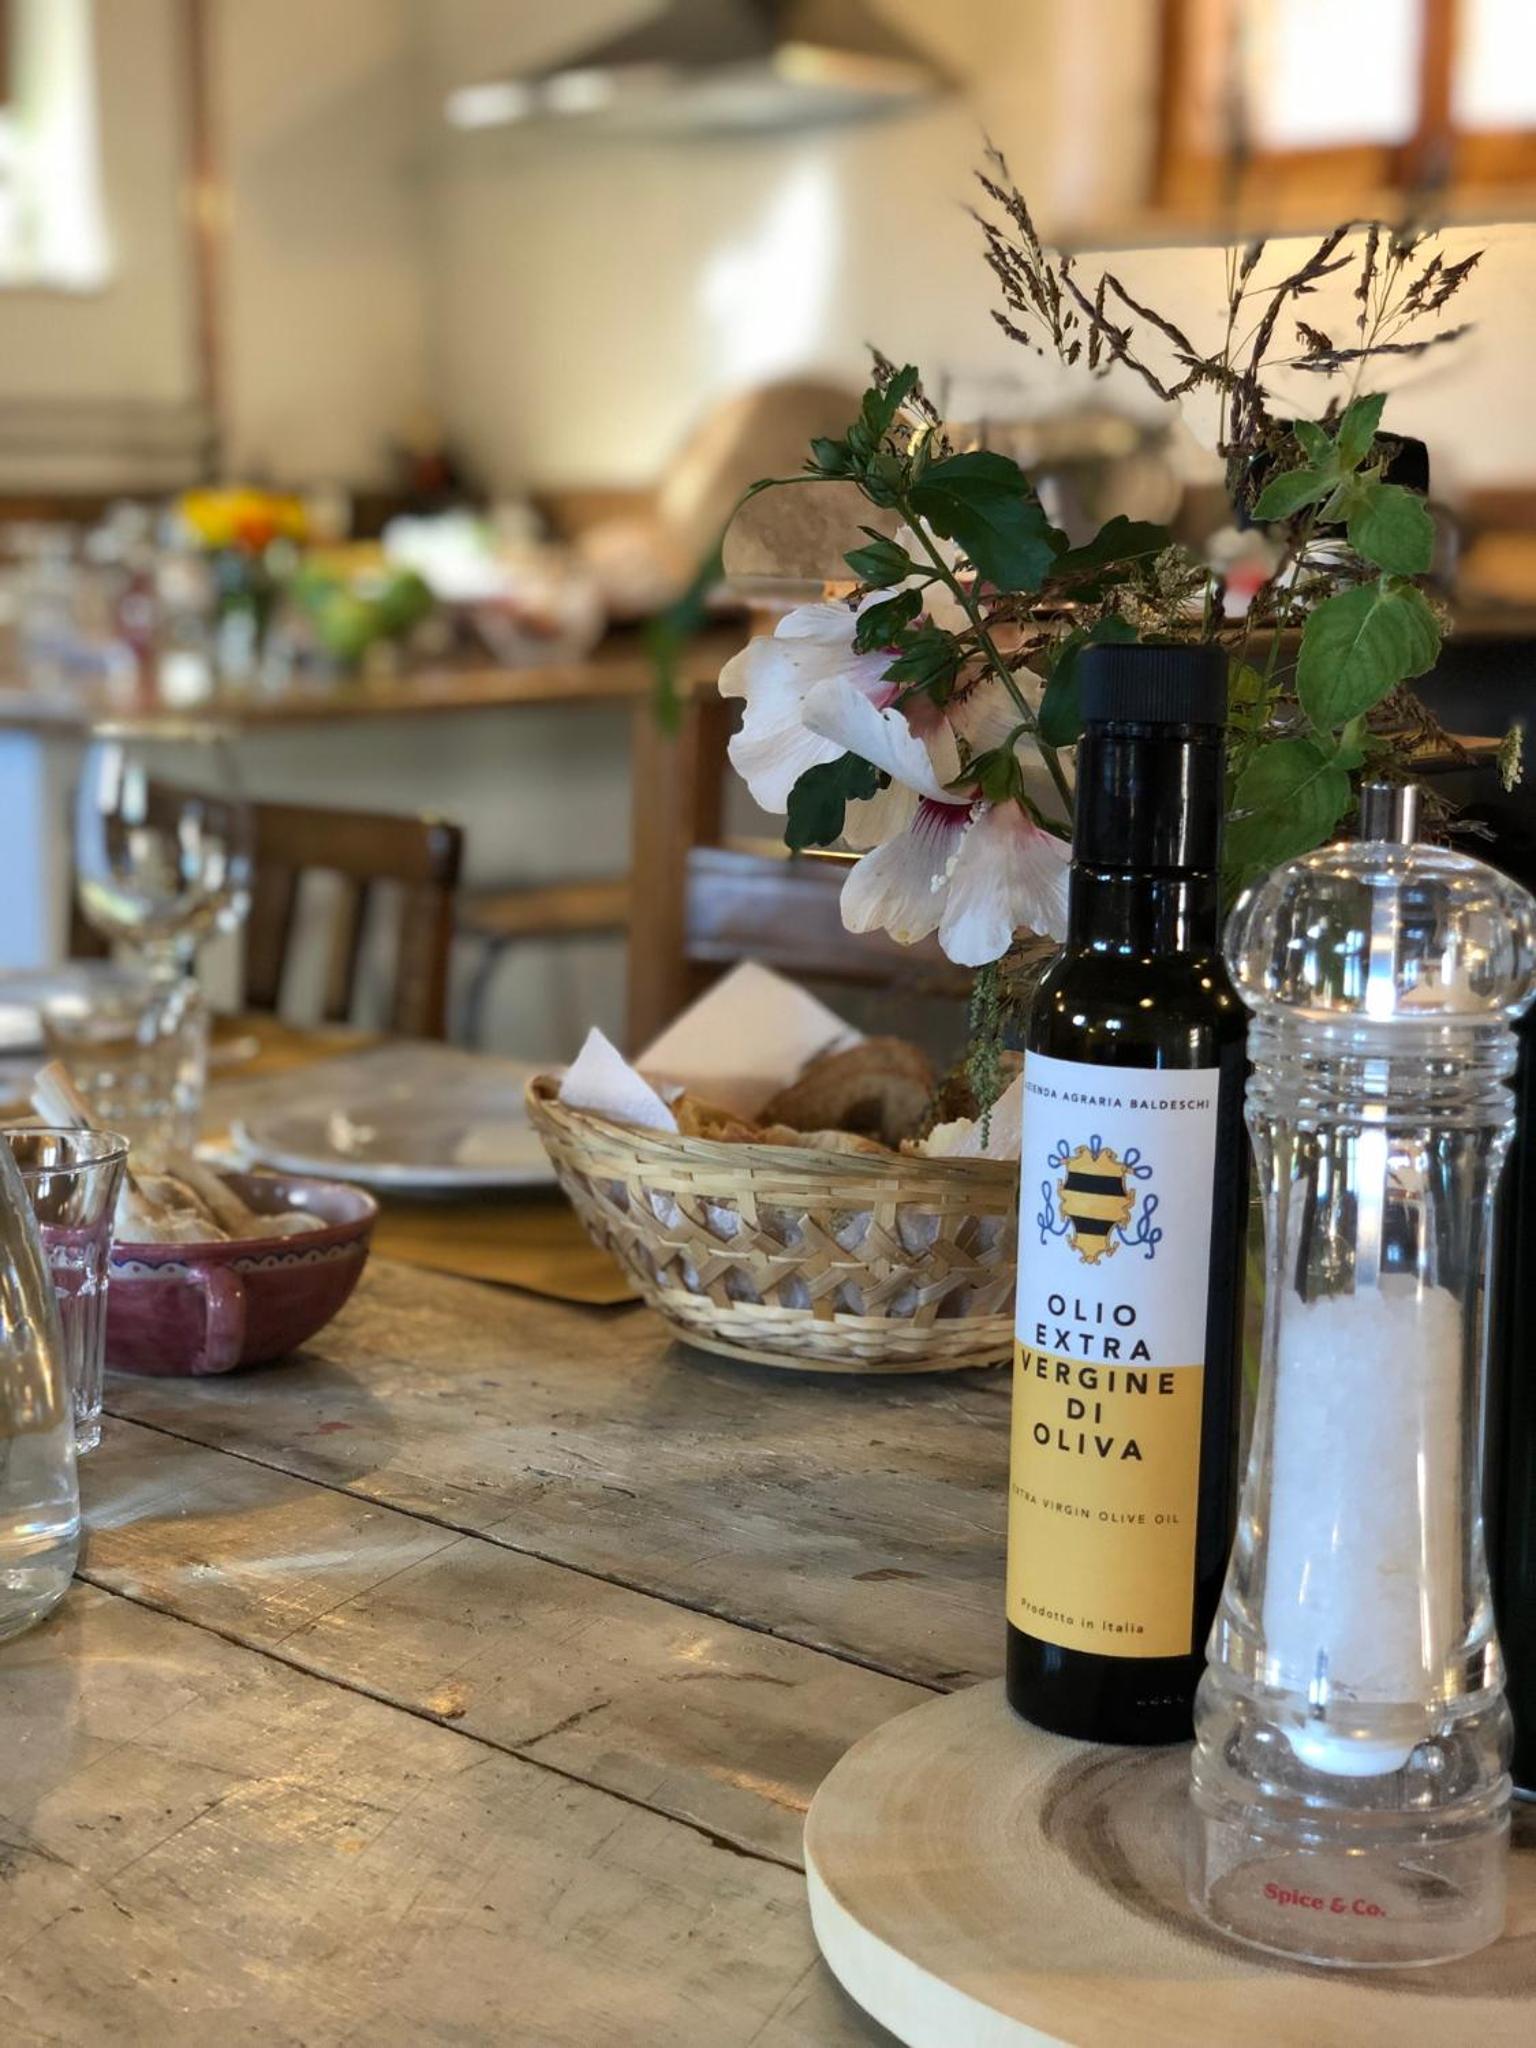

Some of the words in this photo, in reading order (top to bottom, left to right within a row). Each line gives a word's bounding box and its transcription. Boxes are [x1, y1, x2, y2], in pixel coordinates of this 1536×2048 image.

[1063, 1091, 1122, 1108] AGRARIA
[1130, 1098, 1209, 1110] BALDESCHI
[1048, 1294, 1137, 1326] OLIO
[1035, 1323, 1151, 1361] EXTRA
[1021, 1348, 1175, 1395] VERGINE
[1067, 1398, 1101, 1424] DI
[1033, 1423, 1143, 1461] OLIVA
[1042, 1499, 1090, 1519] VIRGIN
[1098, 1511, 1145, 1525] OLIVE
[1154, 1513, 1179, 1525] OIL
[1021, 1597, 1074, 1625] Prodotto
[1081, 1618, 1094, 1629] in
[1102, 1620, 1145, 1634] Italia
[1263, 1882, 1324, 1910] Spice
[1329, 1896, 1347, 1914] &
[1352, 1898, 1386, 1917] Co.
